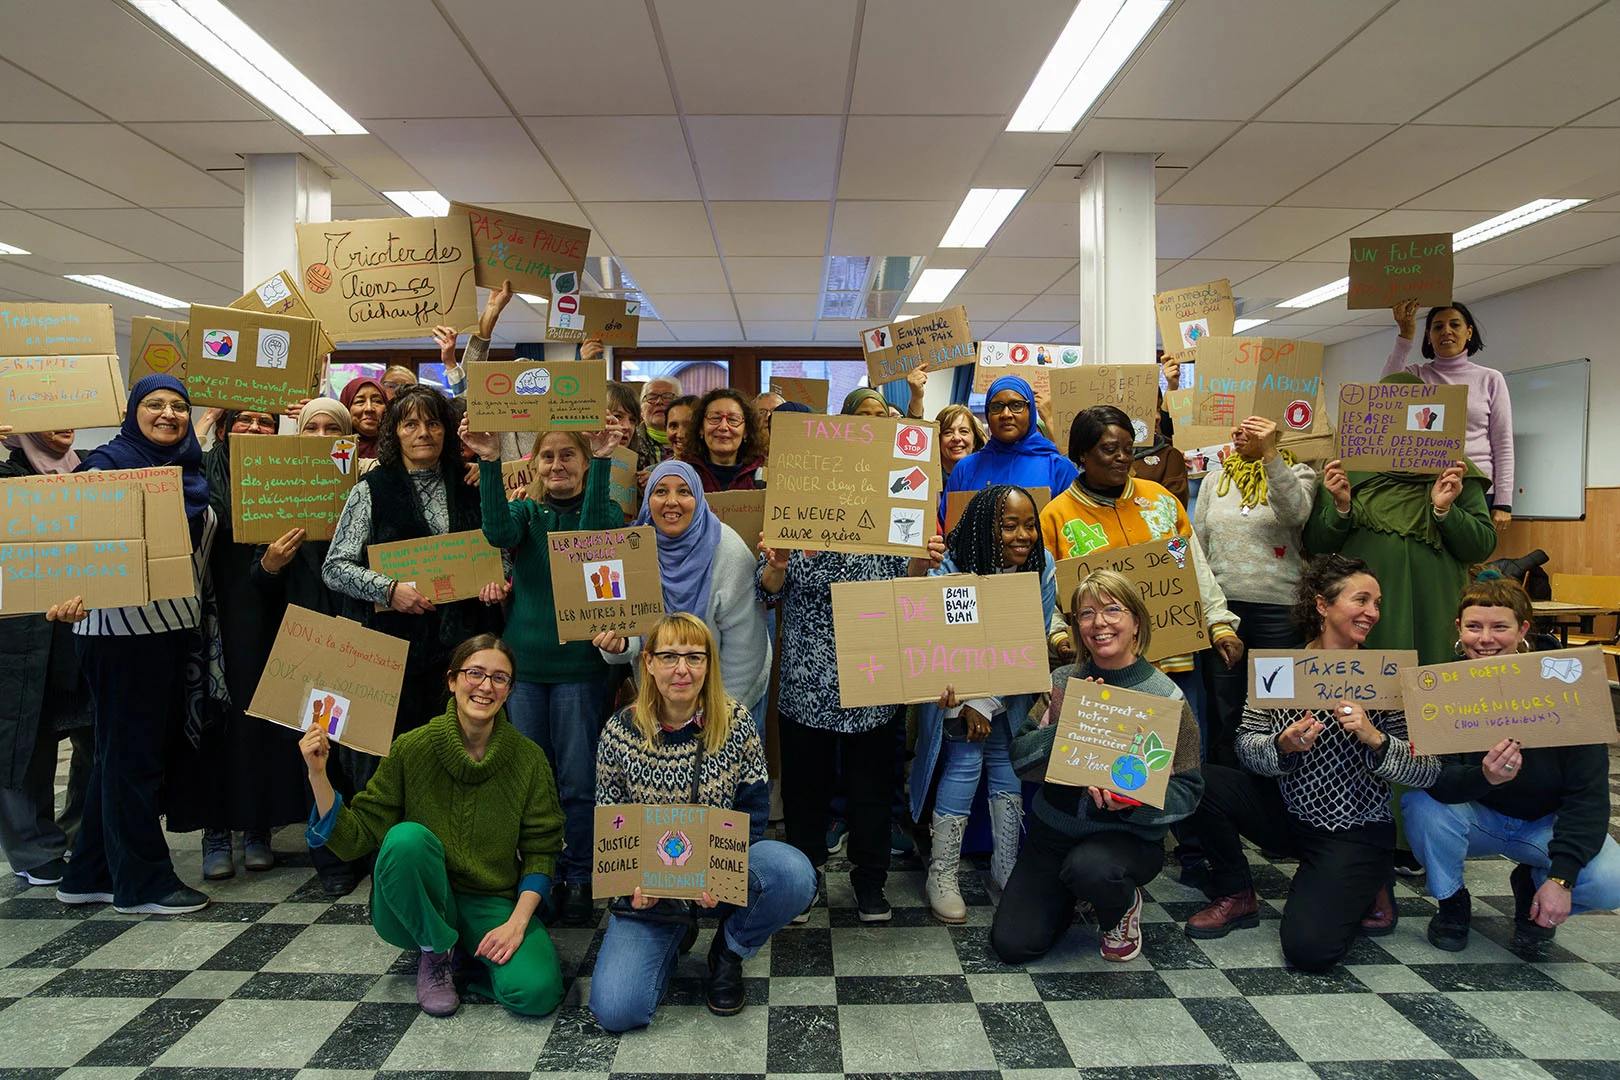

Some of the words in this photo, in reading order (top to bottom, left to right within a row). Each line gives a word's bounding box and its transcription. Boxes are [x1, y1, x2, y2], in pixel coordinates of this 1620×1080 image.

[468, 211, 504, 240] PAS
[507, 227, 524, 244] de
[533, 229, 583, 260] PAUSE
[323, 231, 415, 271] Tricoter
[1353, 247, 1378, 263] UN
[503, 253, 562, 281] CLIMAT
[1383, 264, 1421, 275] POUR
[350, 274, 397, 298] liens
[897, 317, 949, 340] Ensemble
[895, 341, 914, 354] pour
[916, 337, 926, 347] la
[929, 330, 954, 342] PAIX
[929, 341, 975, 366] SOCIALE
[1234, 341, 1295, 366] STOP
[1059, 380, 1077, 395] DE
[1089, 370, 1153, 394] LIBERTÉ
[231, 394, 267, 406] monde
[1096, 390, 1136, 404] POUR
[1369, 384, 1439, 401] D'ARGENT
[1343, 411, 1362, 423] LES
[1363, 413, 1398, 425] ASBL
[803, 419, 874, 444] TAXES
[903, 444, 921, 452] STOP
[1391, 435, 1414, 447] DES
[311, 458, 334, 467] pas
[776, 450, 845, 473] ARRÊTEZ
[855, 458, 872, 473] de
[1420, 449, 1448, 458] POUR
[108, 468, 179, 482] SOLUTIONS,
[241, 473, 262, 487] des
[264, 477, 307, 491] jeunes
[310, 473, 341, 486] dans
[776, 473, 821, 492] PIQUER
[826, 477, 856, 492] dans
[861, 478, 877, 492] la
[7, 486, 129, 507] POLITIQUE
[145, 481, 179, 494] DES
[241, 507, 274, 522] dans
[297, 507, 341, 524] drogu
[771, 506, 791, 521] DE
[797, 508, 846, 521] WEVER
[8, 515, 80, 535] C'EST
[0, 543, 78, 563] ROUVER
[93, 541, 129, 553] DES
[552, 538, 570, 553] LES
[614, 533, 626, 545] LA
[1144, 552, 1170, 568] DE
[946, 587, 969, 599] BLAH
[1135, 577, 1183, 600] PLUS
[558, 609, 576, 622] LES
[580, 606, 616, 621] AUTRES
[898, 596, 935, 622] DE
[945, 599, 976, 611] BLAH!!
[946, 611, 973, 623] BLAH
[281, 620, 314, 642] NON
[325, 635, 336, 649] la
[338, 641, 404, 671] stigmatisation
[904, 639, 1036, 679] D'ACTIONS
[1295, 656, 1365, 676] TAXER
[1380, 655, 1398, 675] les
[1441, 671, 1459, 683] DE
[1077, 709, 1109, 723] notre
[1094, 702, 1135, 717] respect
[1135, 712, 1147, 720] de
[645, 807, 708, 825] RESPECT
[597, 835, 641, 854] JUSTICE
[709, 834, 747, 853] PRESSION
[596, 857, 639, 874] SOCIALE
[709, 855, 745, 874] SOCIALE
